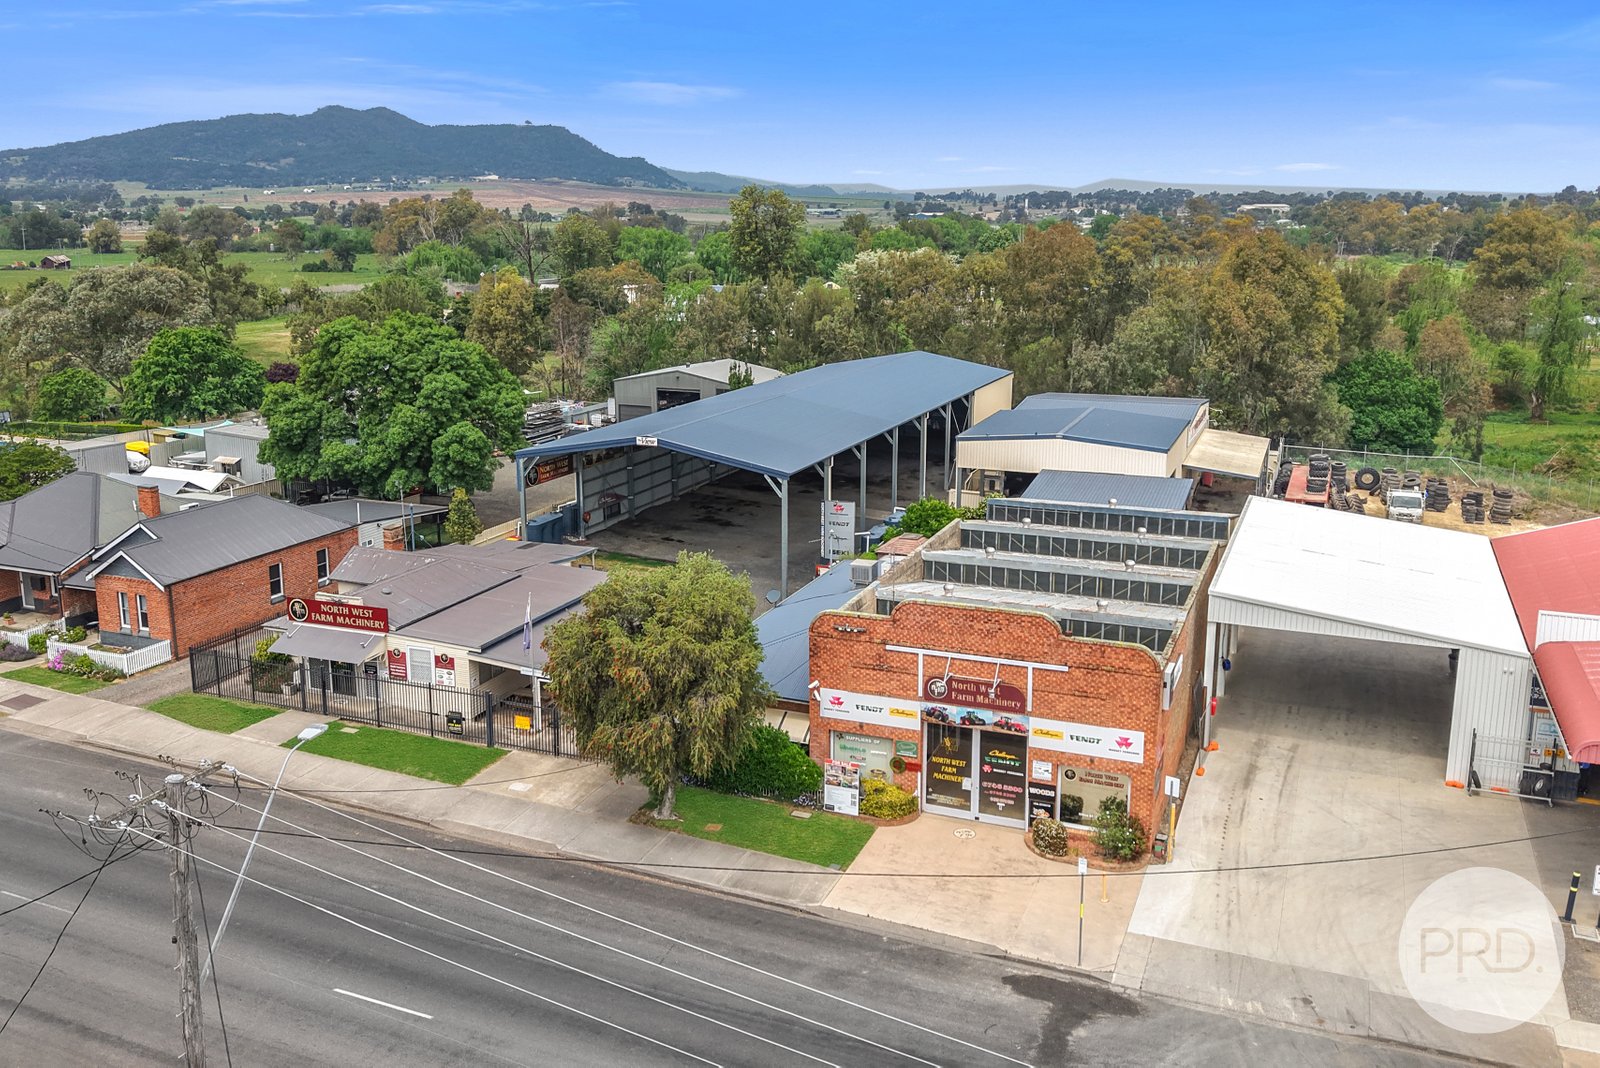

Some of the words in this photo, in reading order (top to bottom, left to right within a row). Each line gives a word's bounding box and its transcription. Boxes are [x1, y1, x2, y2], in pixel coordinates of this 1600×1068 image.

[320, 604, 349, 615] NORTH
[351, 607, 373, 618] WEST
[311, 612, 334, 623] FARM
[336, 616, 385, 629] MACHINERY
[951, 680, 977, 692] North
[979, 684, 1001, 695] Wt
[951, 691, 975, 702] Farm
[976, 695, 1021, 709] Machinery
[855, 704, 885, 713] FENDT
[845, 735, 872, 743] SUPPLIERS
[1069, 734, 1103, 745] FENDT
[931, 756, 951, 765] NORTH
[951, 760, 967, 768] WEST
[941, 765, 957, 774] FARM
[1029, 787, 1055, 797] WOODS
